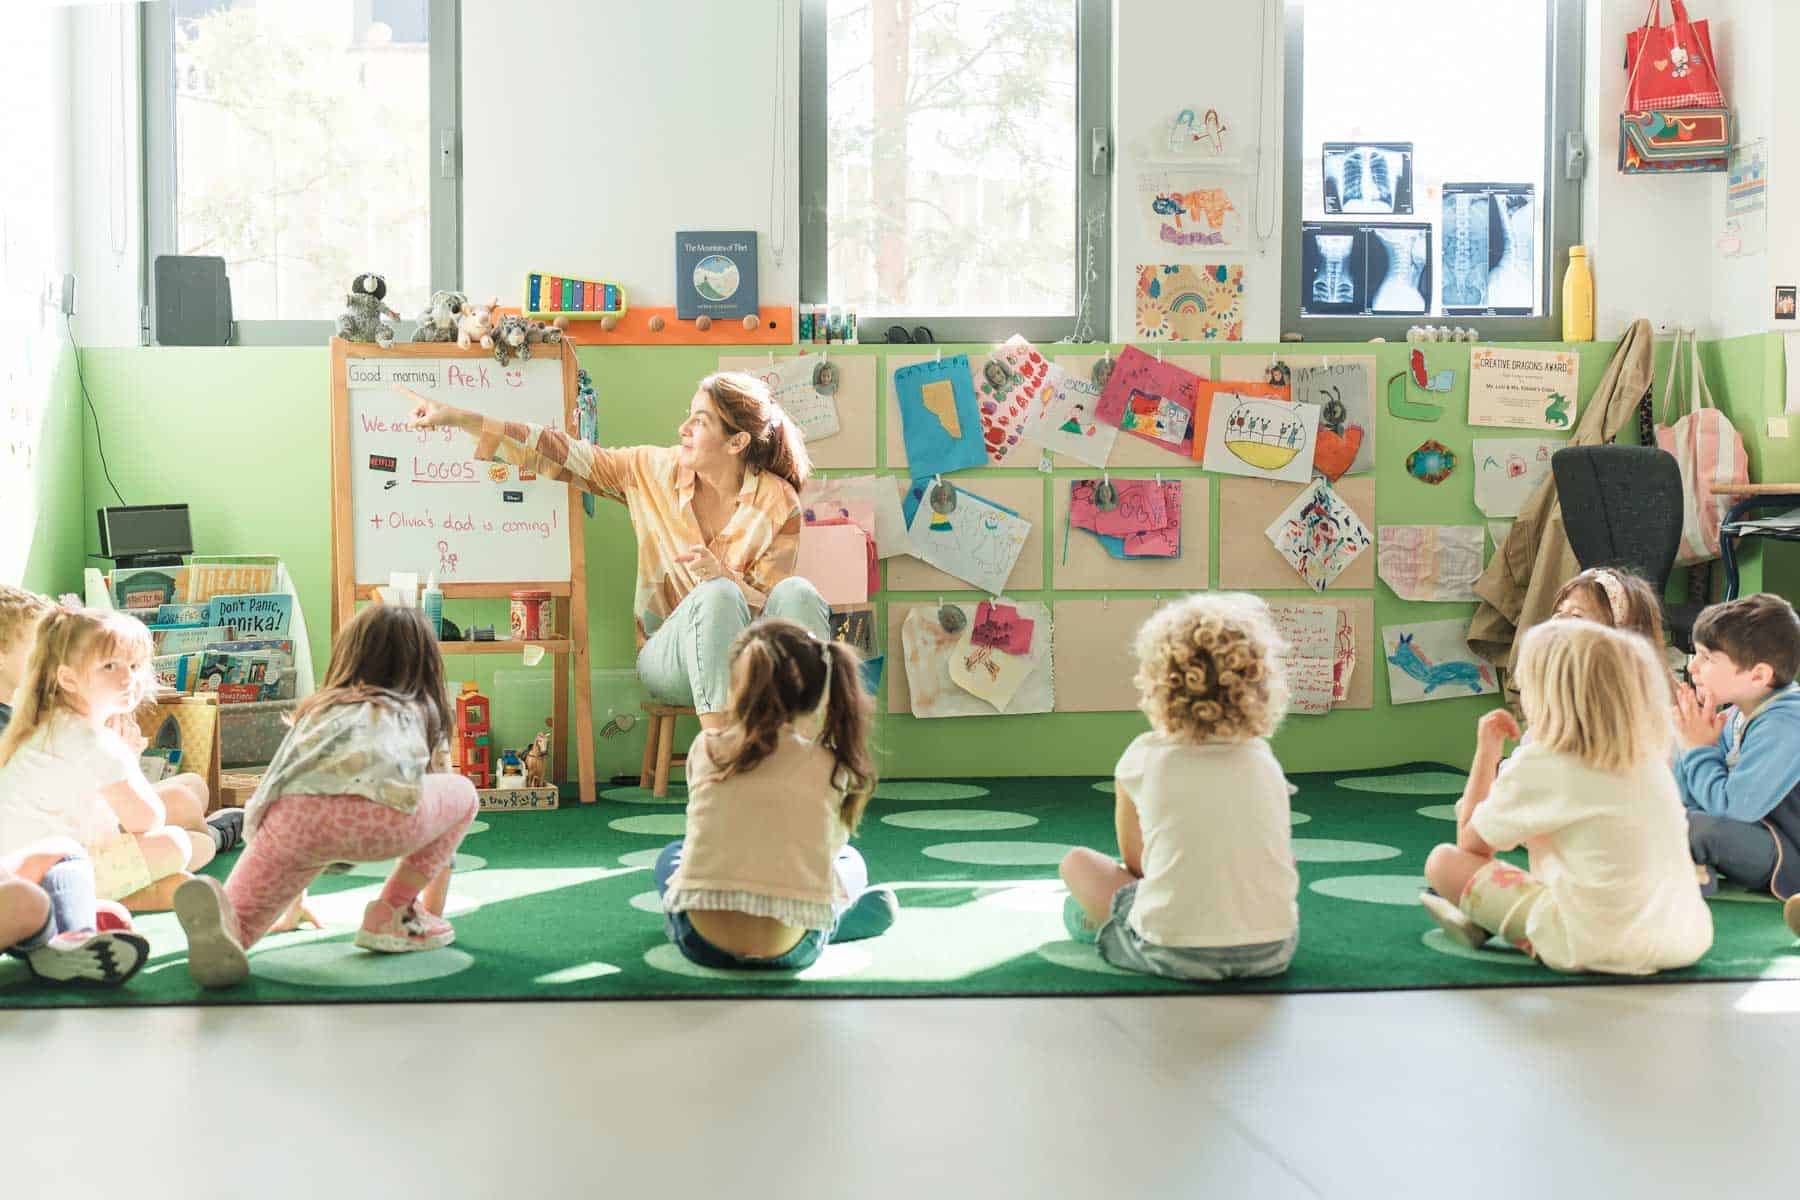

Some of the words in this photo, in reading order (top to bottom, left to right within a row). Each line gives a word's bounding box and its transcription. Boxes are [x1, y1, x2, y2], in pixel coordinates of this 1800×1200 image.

[1480, 358, 1510, 369] CREATIVE
[1511, 360, 1543, 371] DRAGONS
[1544, 363, 1568, 373] AWARD
[350, 365, 381, 382] Good
[393, 370, 436, 388] morning
[361, 413, 387, 433] We
[389, 509, 434, 529] Olivia's
[443, 513, 473, 532] dad
[484, 518, 493, 532] is
[220, 600, 246, 616] Don't
[249, 598, 280, 613] Panic,
[218, 612, 284, 632] Annika!
